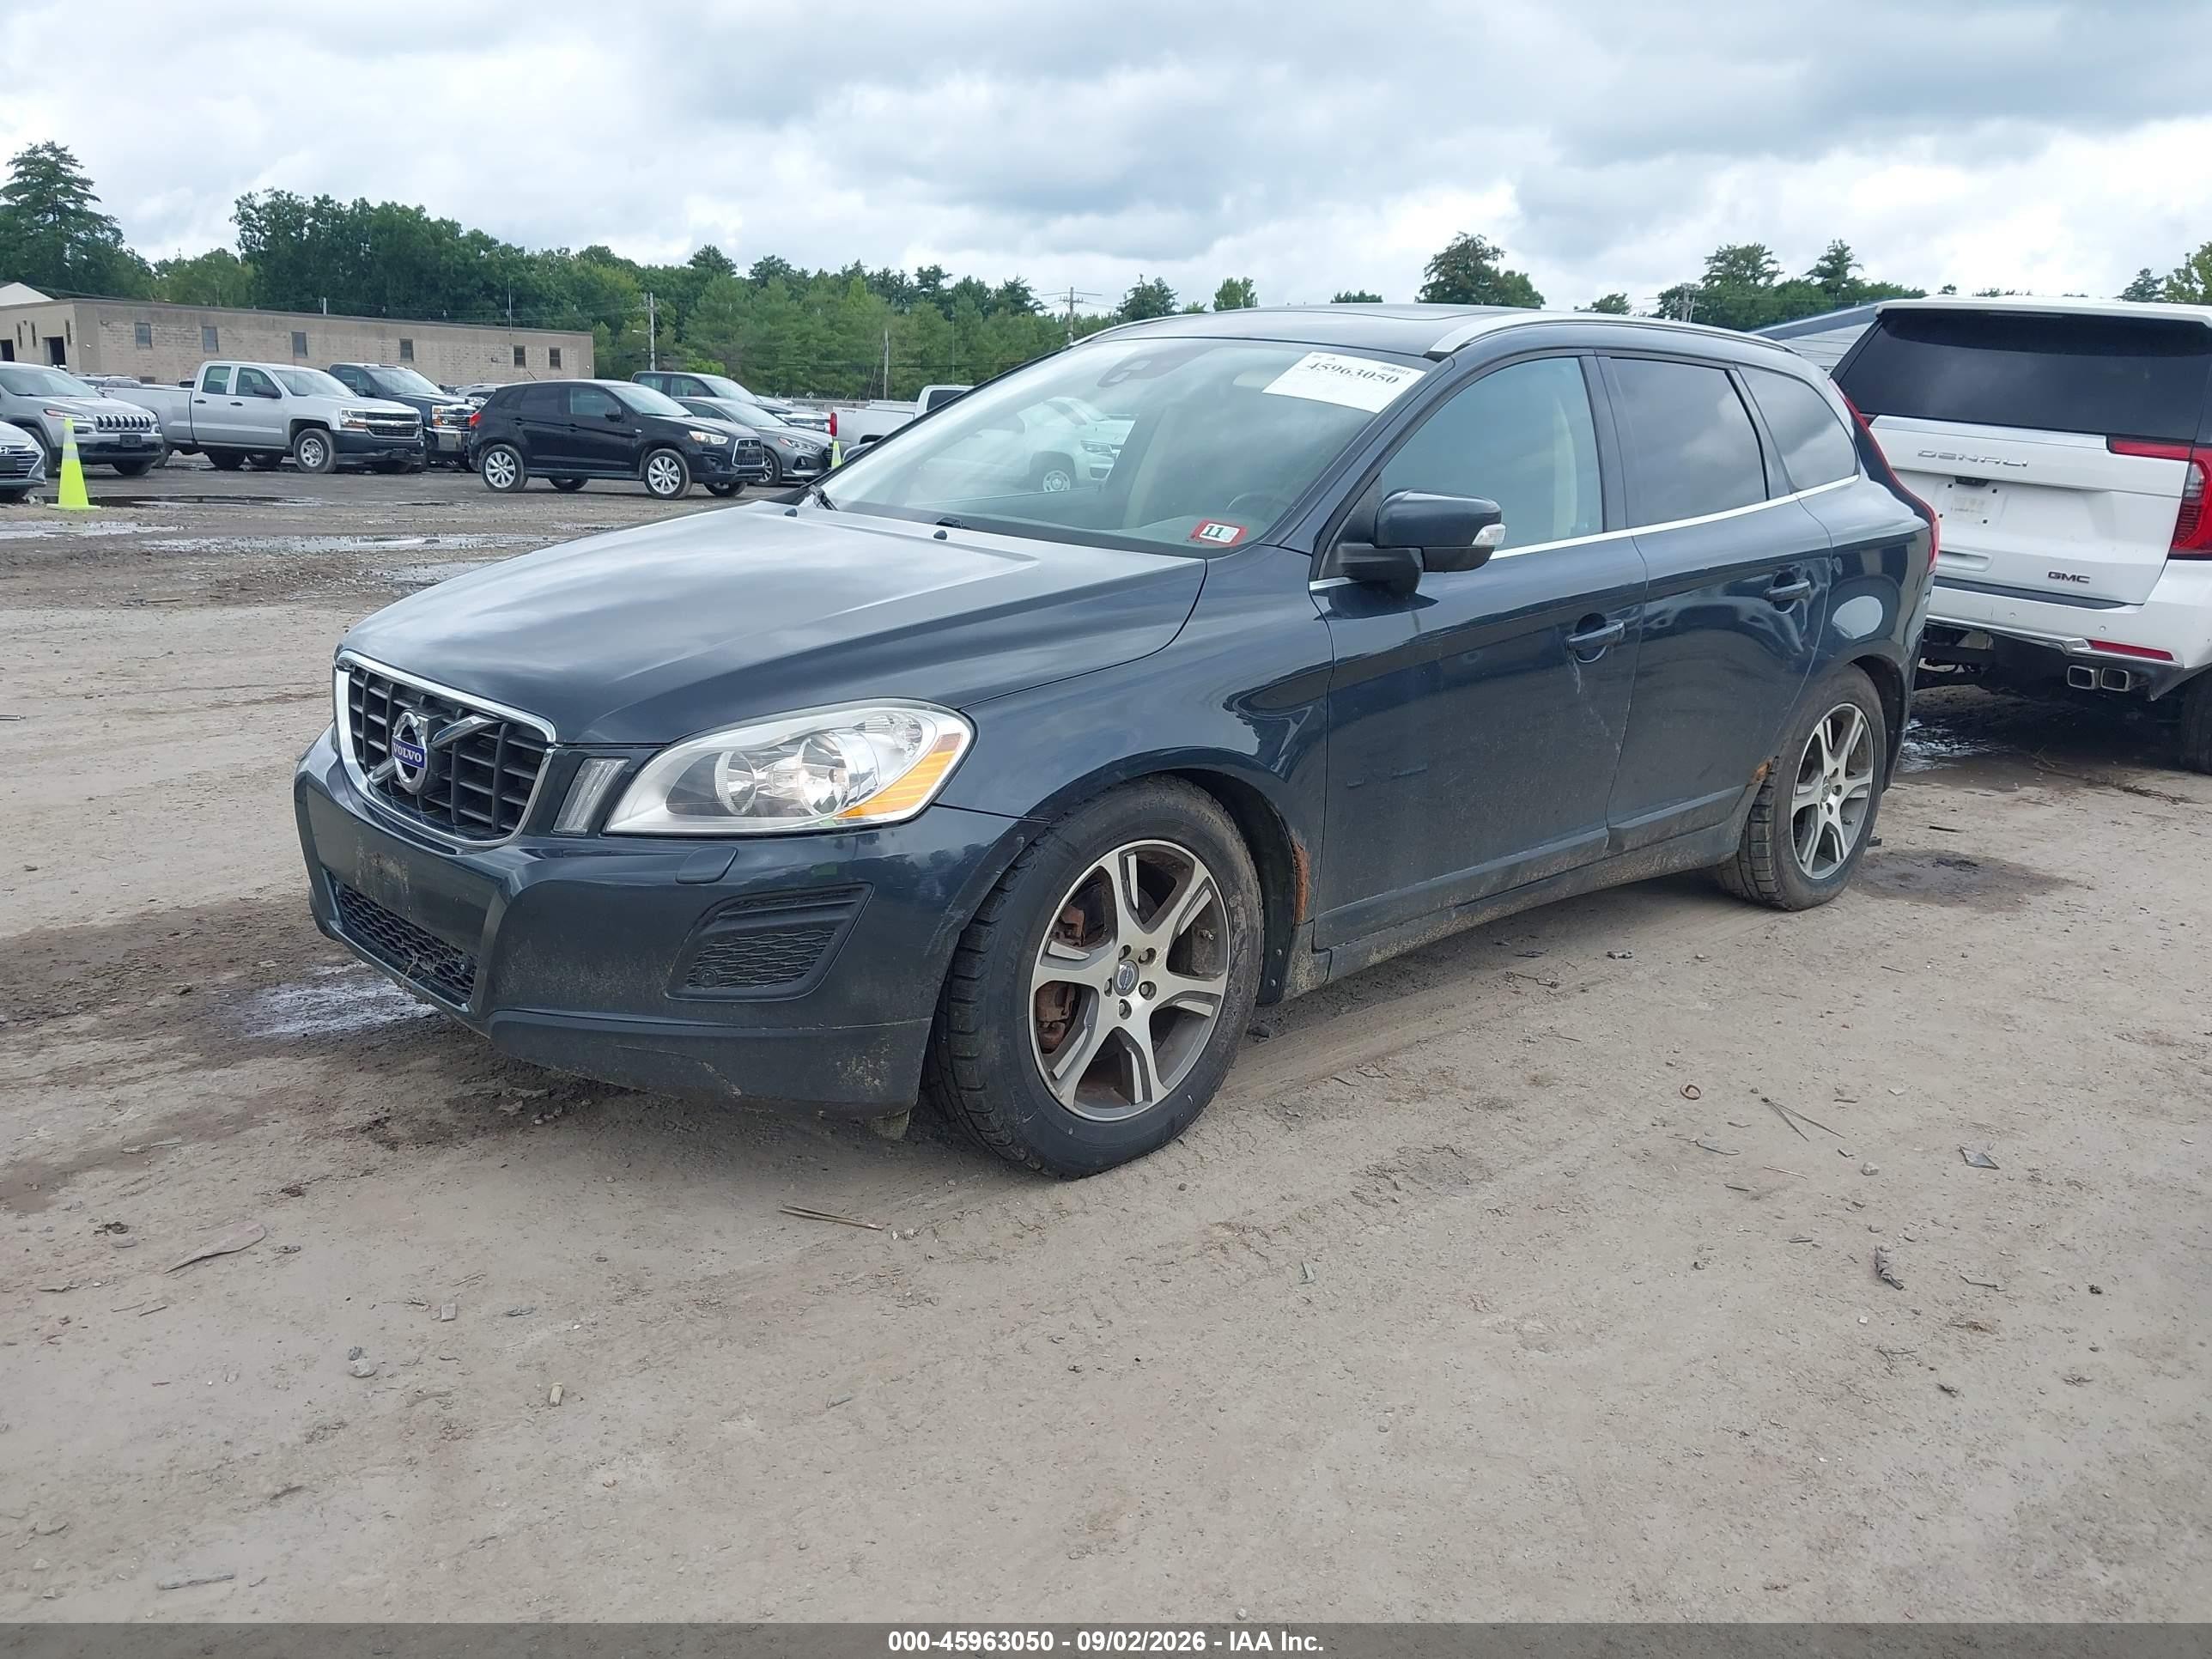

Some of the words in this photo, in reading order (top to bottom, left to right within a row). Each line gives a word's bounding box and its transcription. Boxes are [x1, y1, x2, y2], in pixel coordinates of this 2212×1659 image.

[1306, 362, 1400, 384] 45963050
[1917, 449, 2028, 468] DENALI
[1201, 525, 1224, 538] 11
[2047, 571, 2091, 584] GMC
[392, 742, 422, 763] VOLVO
